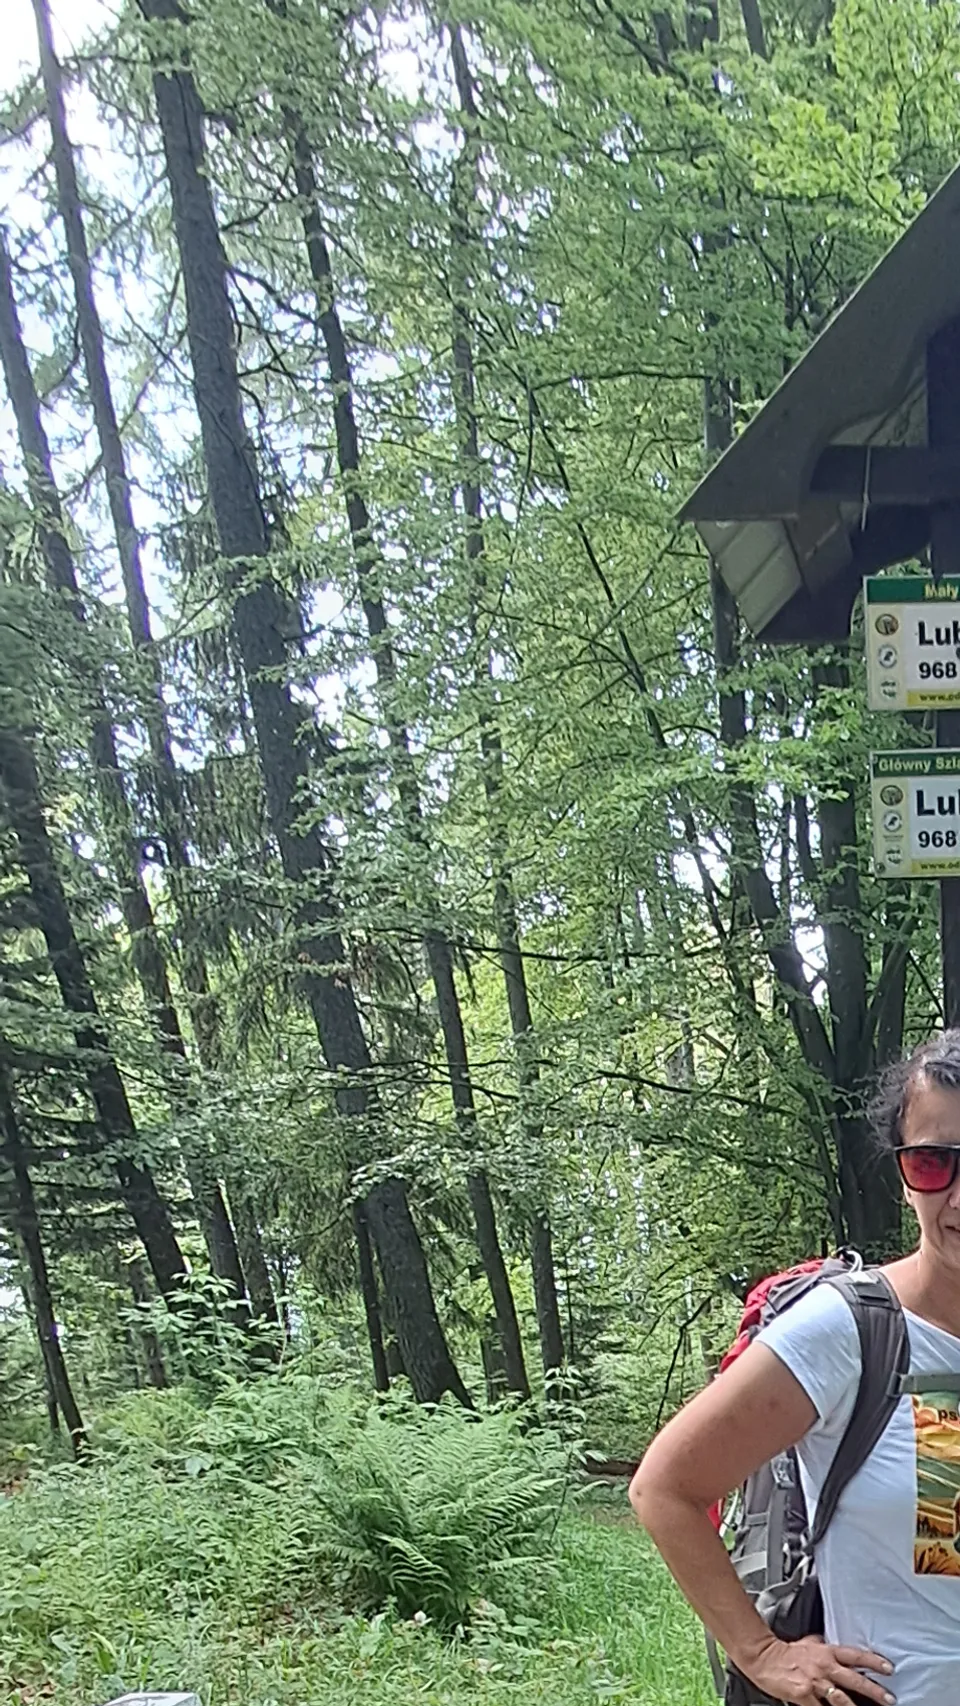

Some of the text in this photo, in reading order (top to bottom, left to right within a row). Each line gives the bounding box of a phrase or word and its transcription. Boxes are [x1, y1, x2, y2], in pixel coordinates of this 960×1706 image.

[918, 661, 958, 680] 968
[878, 757, 931, 774] Główny
[917, 830, 958, 849] 968
